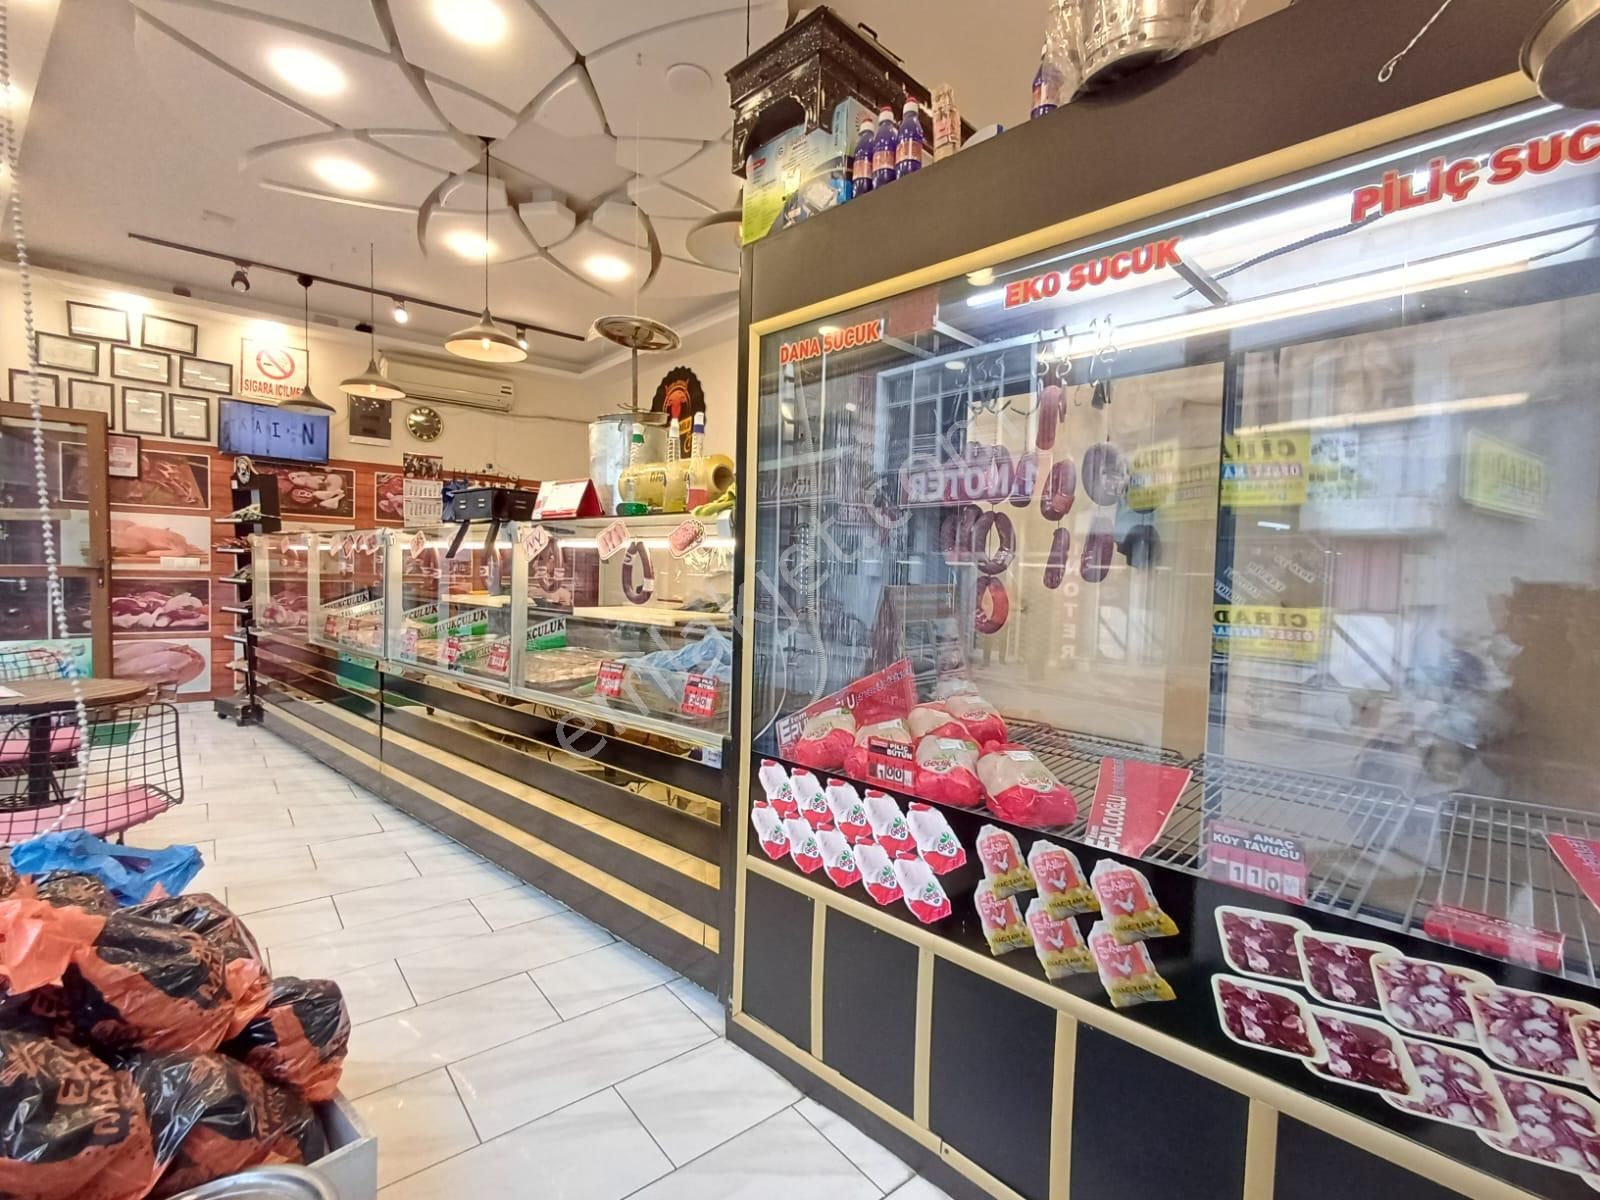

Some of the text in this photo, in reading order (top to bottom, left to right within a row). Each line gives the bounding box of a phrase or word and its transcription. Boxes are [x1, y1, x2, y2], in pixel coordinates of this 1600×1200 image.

[1351, 157, 1481, 223] PİLİÇ
[1004, 236, 1182, 309] EKO SUCUK
[779, 319, 881, 366] DANA SUCUK
[1253, 833, 1295, 850] ANAÇ
